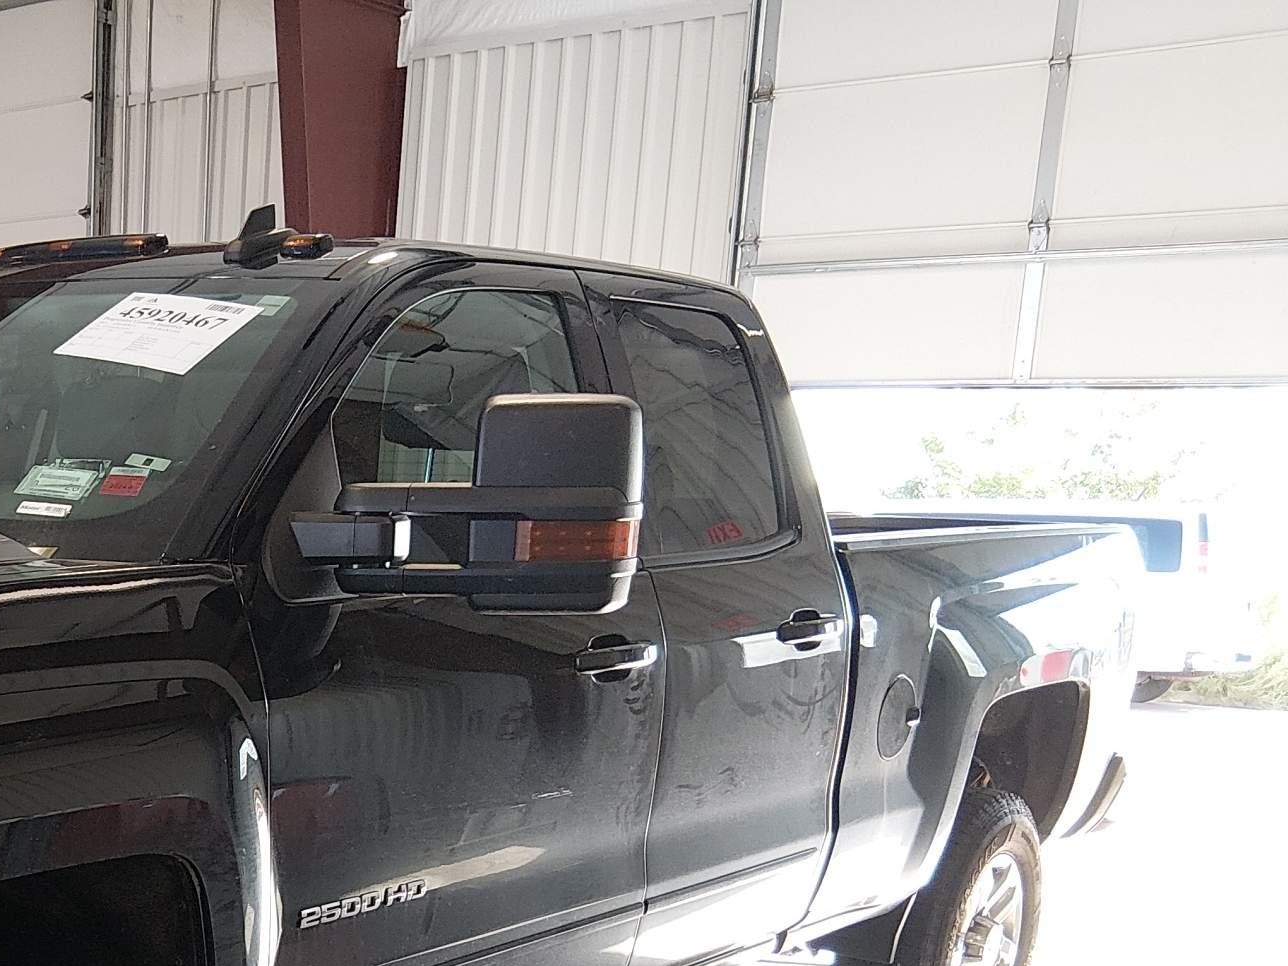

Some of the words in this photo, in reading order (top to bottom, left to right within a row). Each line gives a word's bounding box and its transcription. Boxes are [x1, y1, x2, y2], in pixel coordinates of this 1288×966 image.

[119, 305, 229, 330] 45920467
[298, 890, 383, 930] 2500
[383, 878, 428, 908] HD
